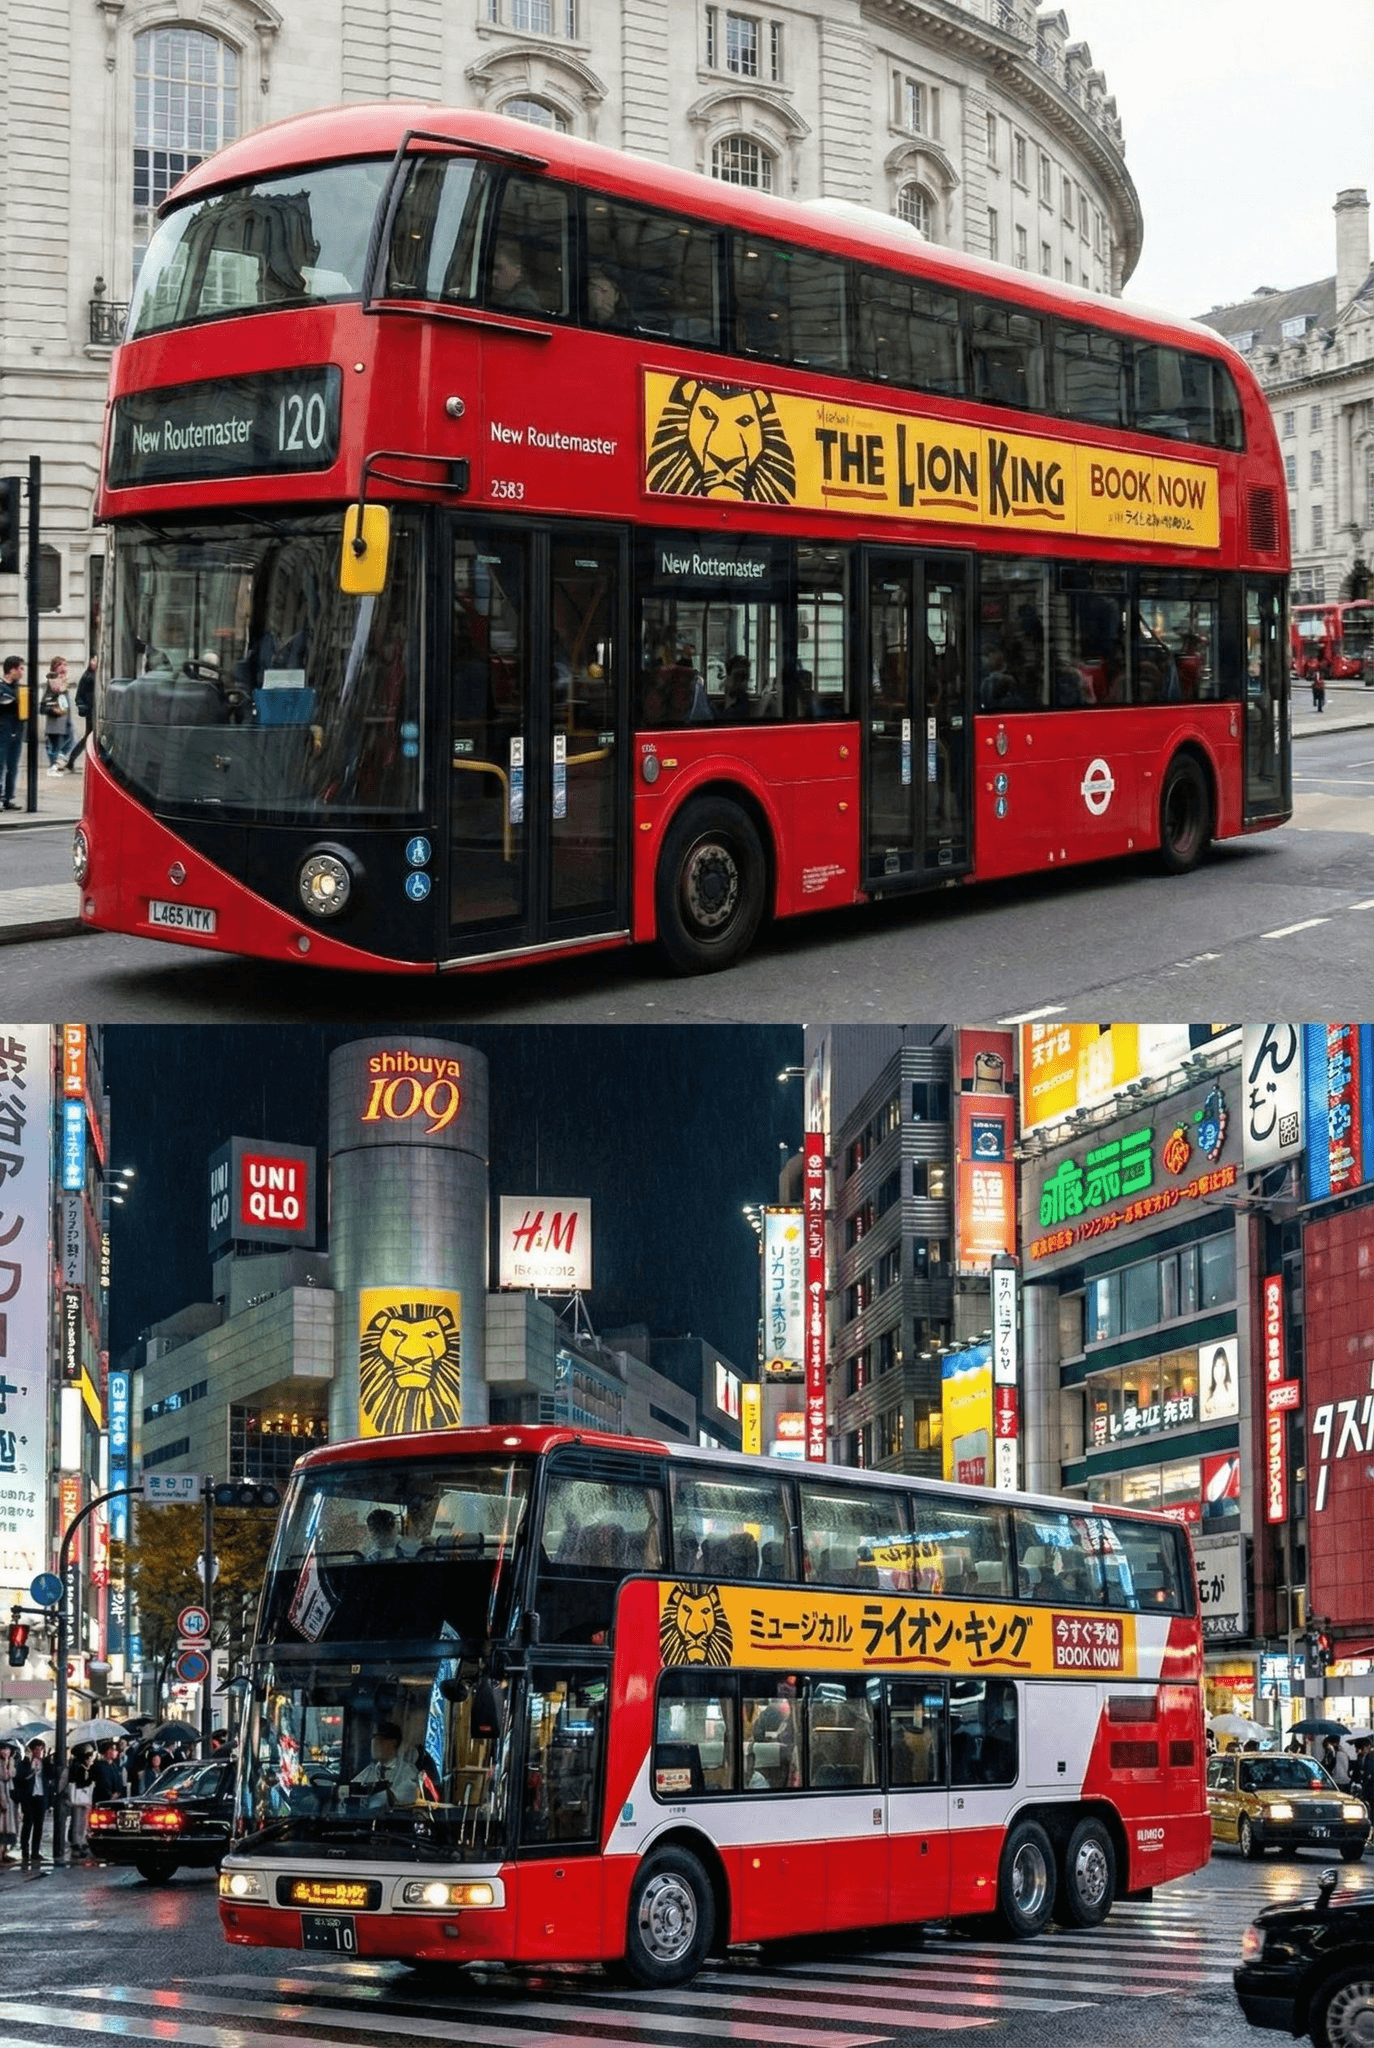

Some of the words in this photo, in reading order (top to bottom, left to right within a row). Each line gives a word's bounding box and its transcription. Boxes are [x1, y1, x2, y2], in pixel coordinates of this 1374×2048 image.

[132, 424, 160, 454] New
[164, 417, 253, 450] Routemaster
[278, 393, 326, 451] 120
[491, 422, 523, 448] New
[527, 425, 618, 456] Routemaster
[815, 427, 885, 486] THE
[490, 479, 525, 500] 2583
[1090, 463, 1152, 503] BOOK
[1157, 474, 1207, 510] NOW
[662, 551, 690, 574] New
[369, 1052, 461, 1079] shibuya
[361, 1077, 461, 1134] 109
[210, 1161, 228, 1192] UNI
[249, 1163, 296, 1191] UNI
[210, 1197, 229, 1231] QLO
[249, 1193, 299, 1221] QLO
[749, 1608, 853, 1643] ミュージカル
[860, 1604, 1033, 1658] ライオン・キング
[1056, 1619, 1119, 1645] 今すぐ予約
[1056, 1646, 1090, 1666] BOOK
[1092, 1648, 1120, 1668] NOW
